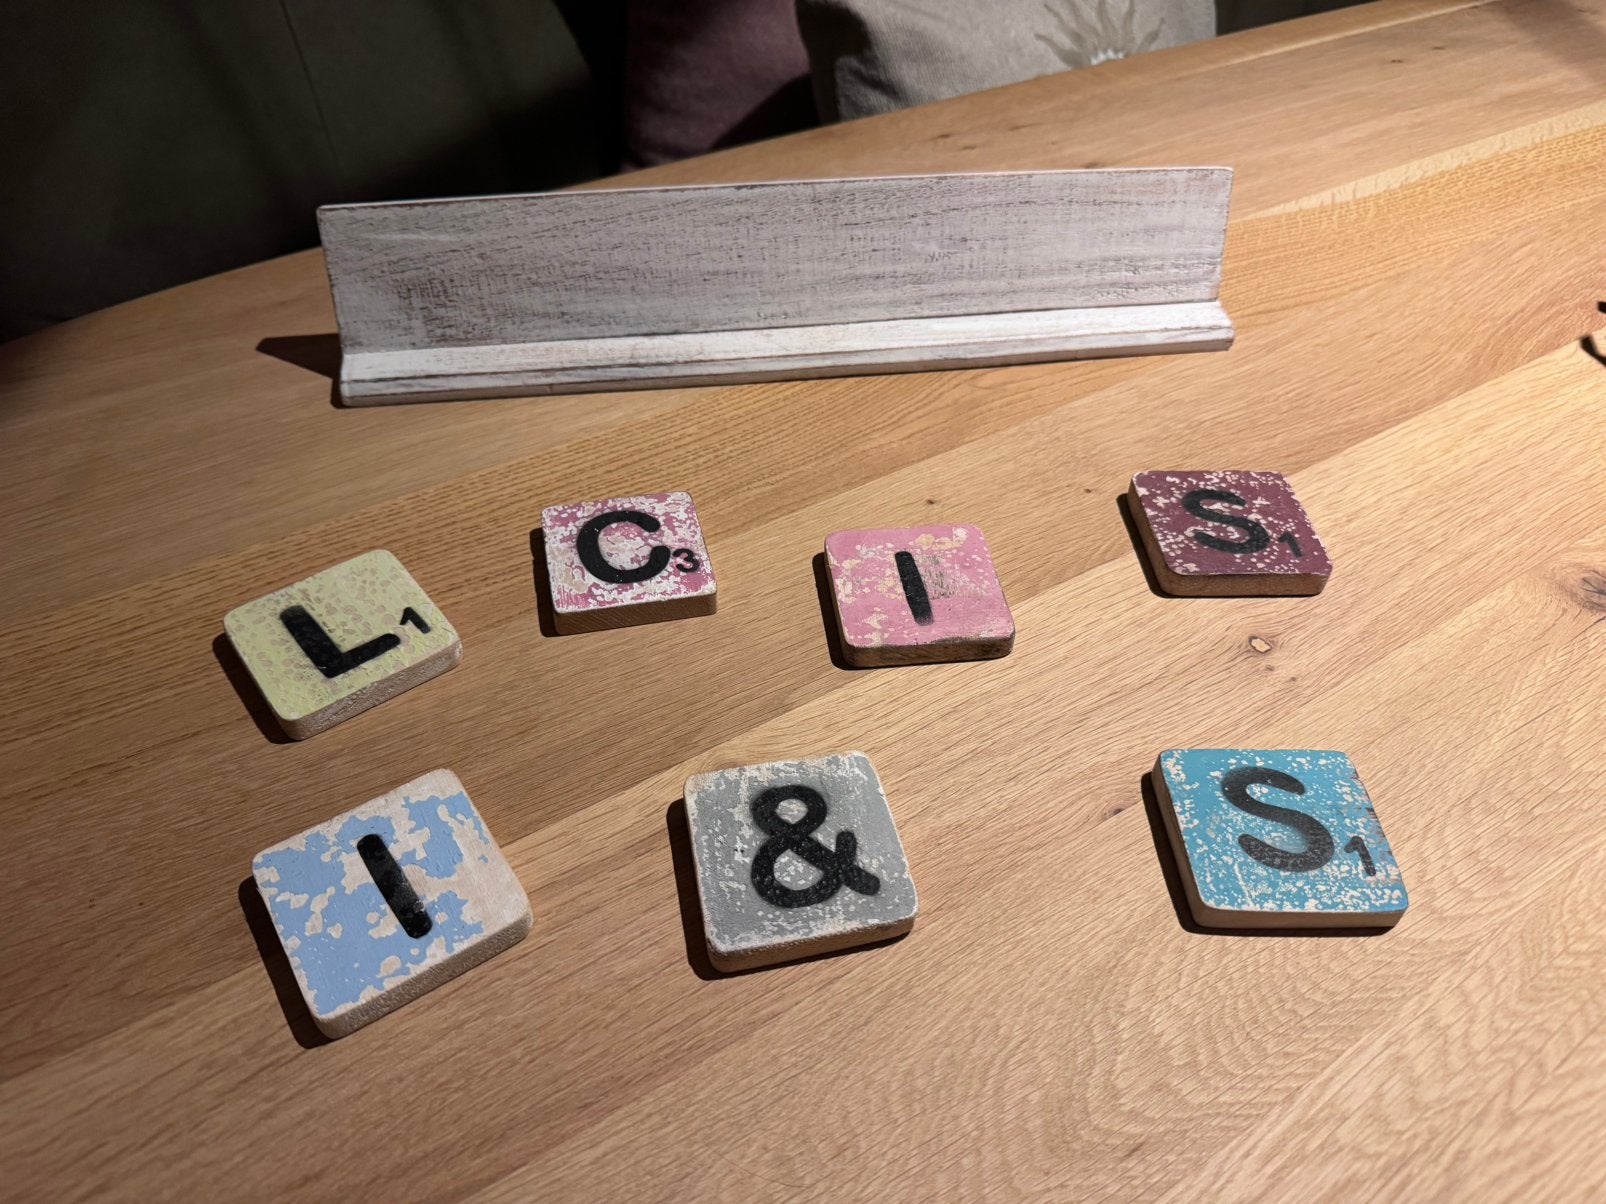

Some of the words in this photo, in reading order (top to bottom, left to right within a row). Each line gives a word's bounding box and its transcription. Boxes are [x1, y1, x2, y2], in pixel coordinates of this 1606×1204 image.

[577, 510, 671, 584] C
[672, 548, 700, 573] 3
[1183, 490, 1269, 555] S
[1277, 533, 1303, 558] 1
[280, 605, 401, 679] L
[400, 606, 431, 634] 1
[750, 784, 880, 908] &
[1221, 766, 1335, 872] S
[1344, 835, 1377, 877] 1
